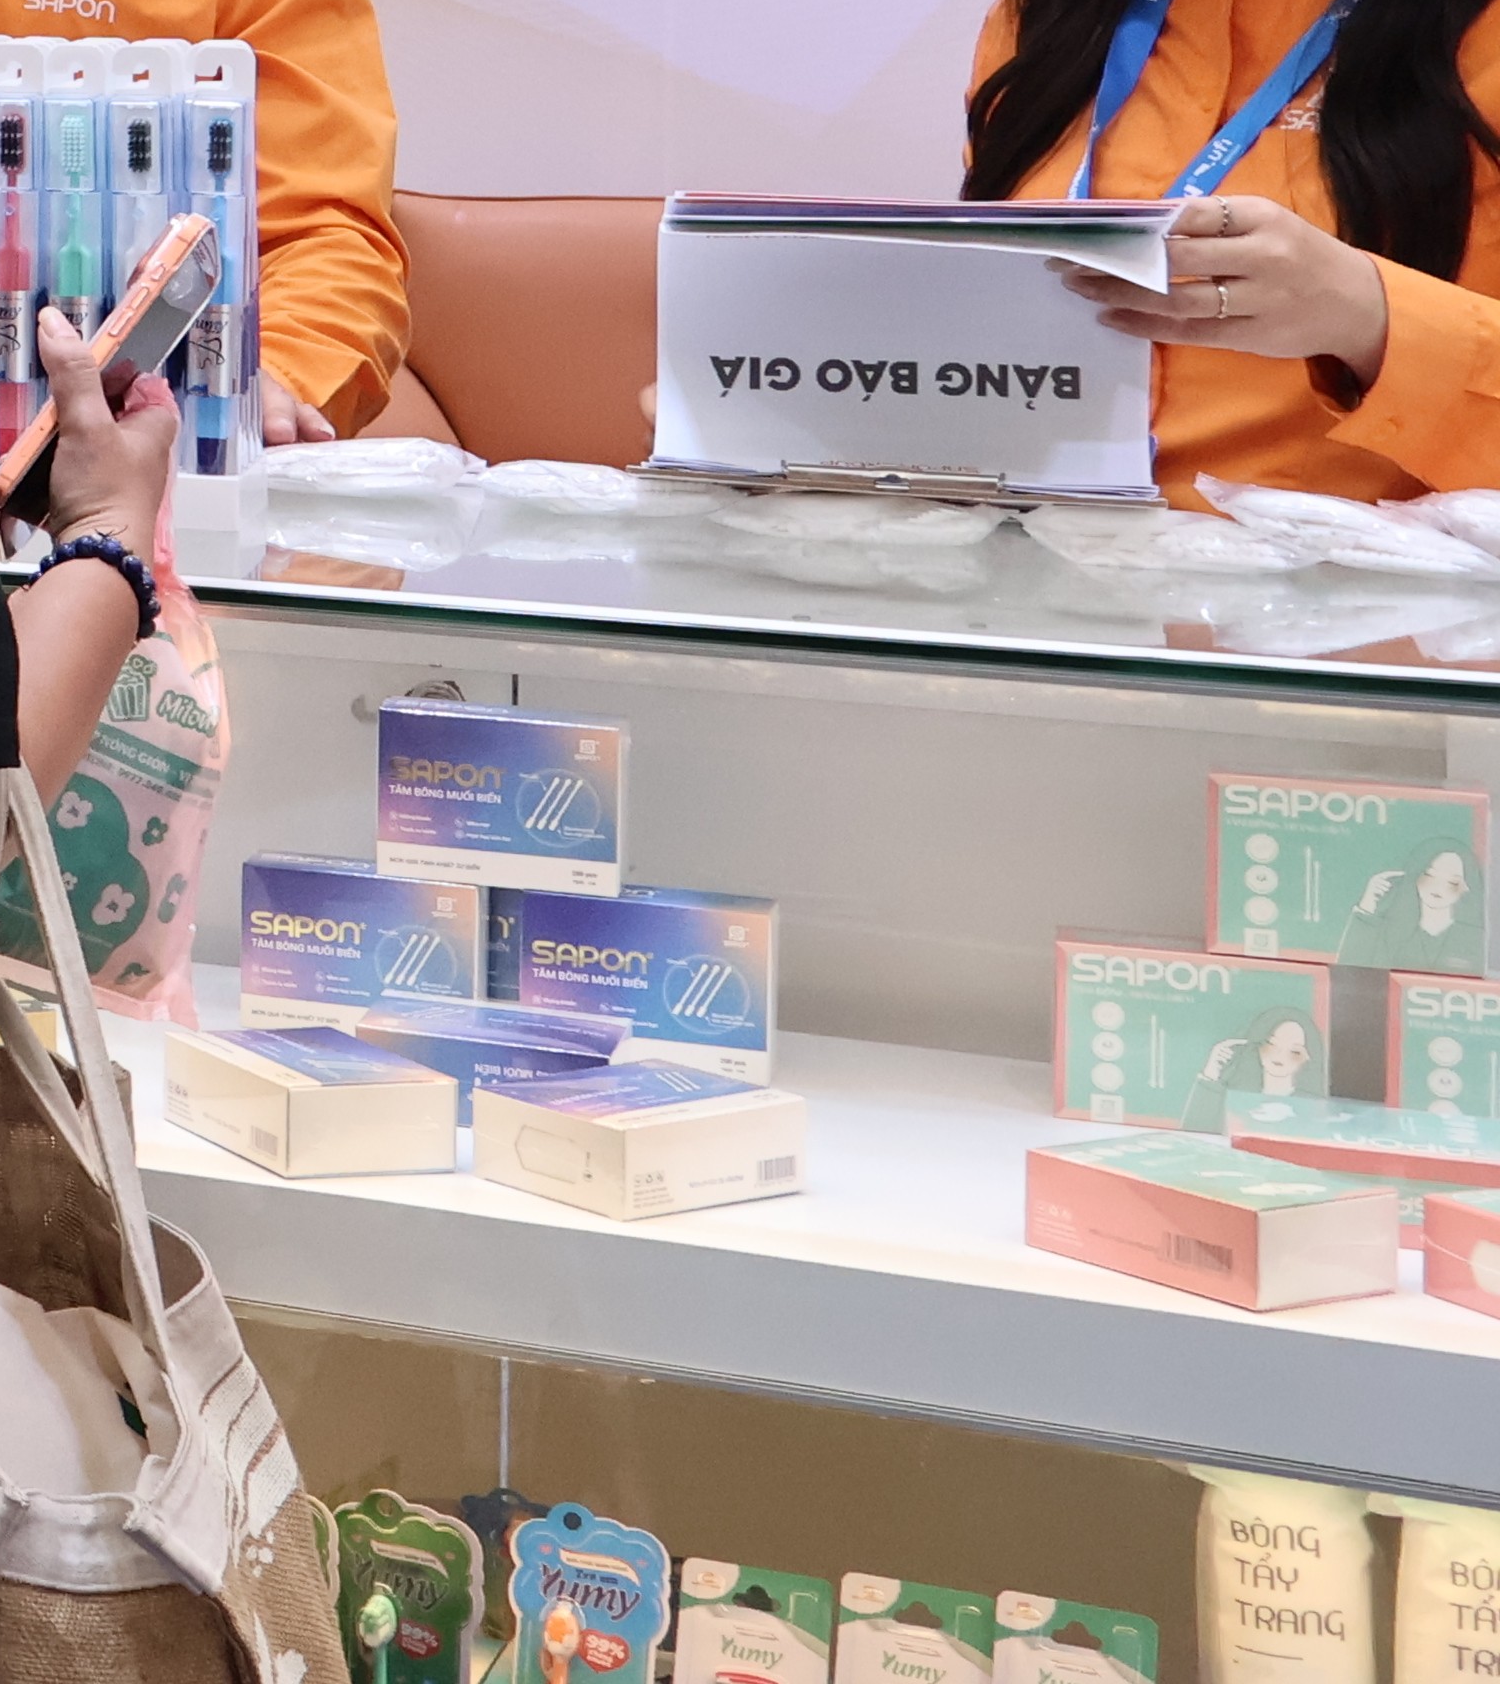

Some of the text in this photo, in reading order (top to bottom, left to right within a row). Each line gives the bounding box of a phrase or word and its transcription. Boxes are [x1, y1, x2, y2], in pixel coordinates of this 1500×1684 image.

[708, 354, 1081, 411] BẢNG BÁO GIÁ
[388, 755, 500, 791] SAPON
[1223, 783, 1388, 825] SAPON
[249, 910, 362, 946] SAPON
[530, 939, 648, 976] SAPON
[1071, 952, 1231, 995] SAPON
[1228, 1517, 1322, 1559] BÔNG
[541, 1562, 642, 1622] Yumy
[1233, 1552, 1300, 1594] TẨY
[1233, 1598, 1347, 1642] TRANG
[719, 1632, 784, 1670] Yumy
